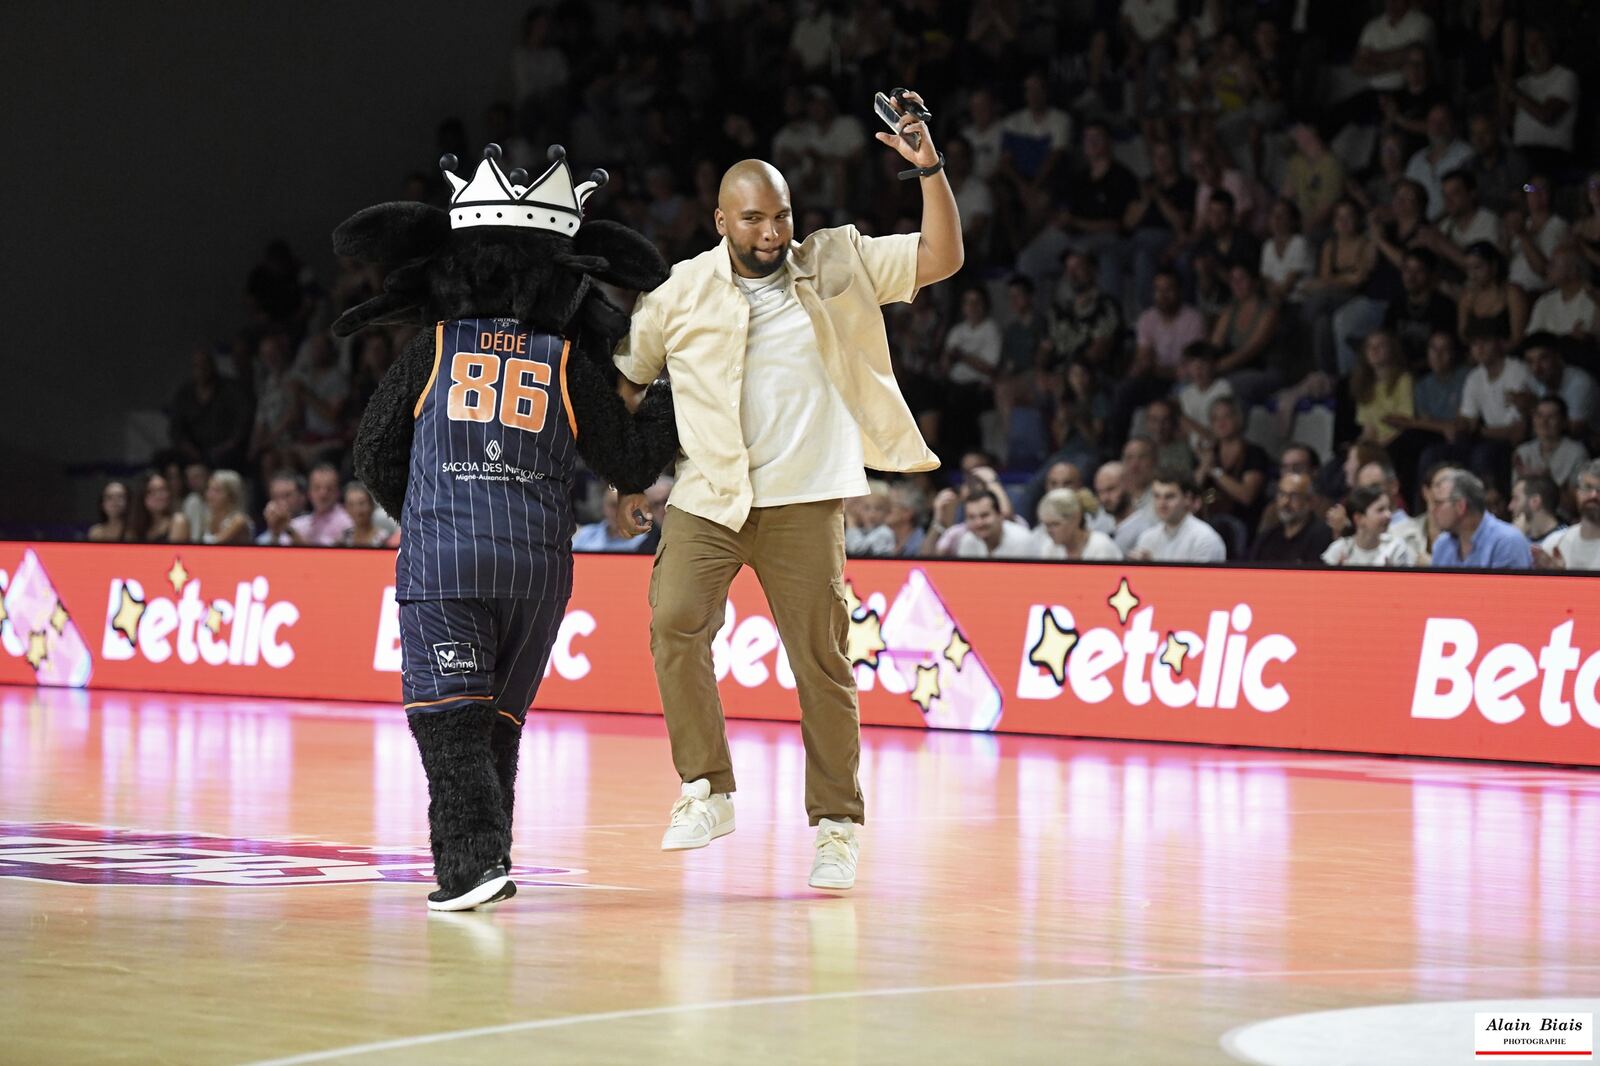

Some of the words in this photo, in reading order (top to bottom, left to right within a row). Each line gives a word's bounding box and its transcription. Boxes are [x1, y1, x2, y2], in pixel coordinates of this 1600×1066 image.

[480, 330, 527, 354] DÉDÉ
[447, 351, 552, 433] 86
[442, 462, 479, 473] SACOA
[482, 462, 502, 473] DES
[1016, 603, 1297, 712] Betclic
